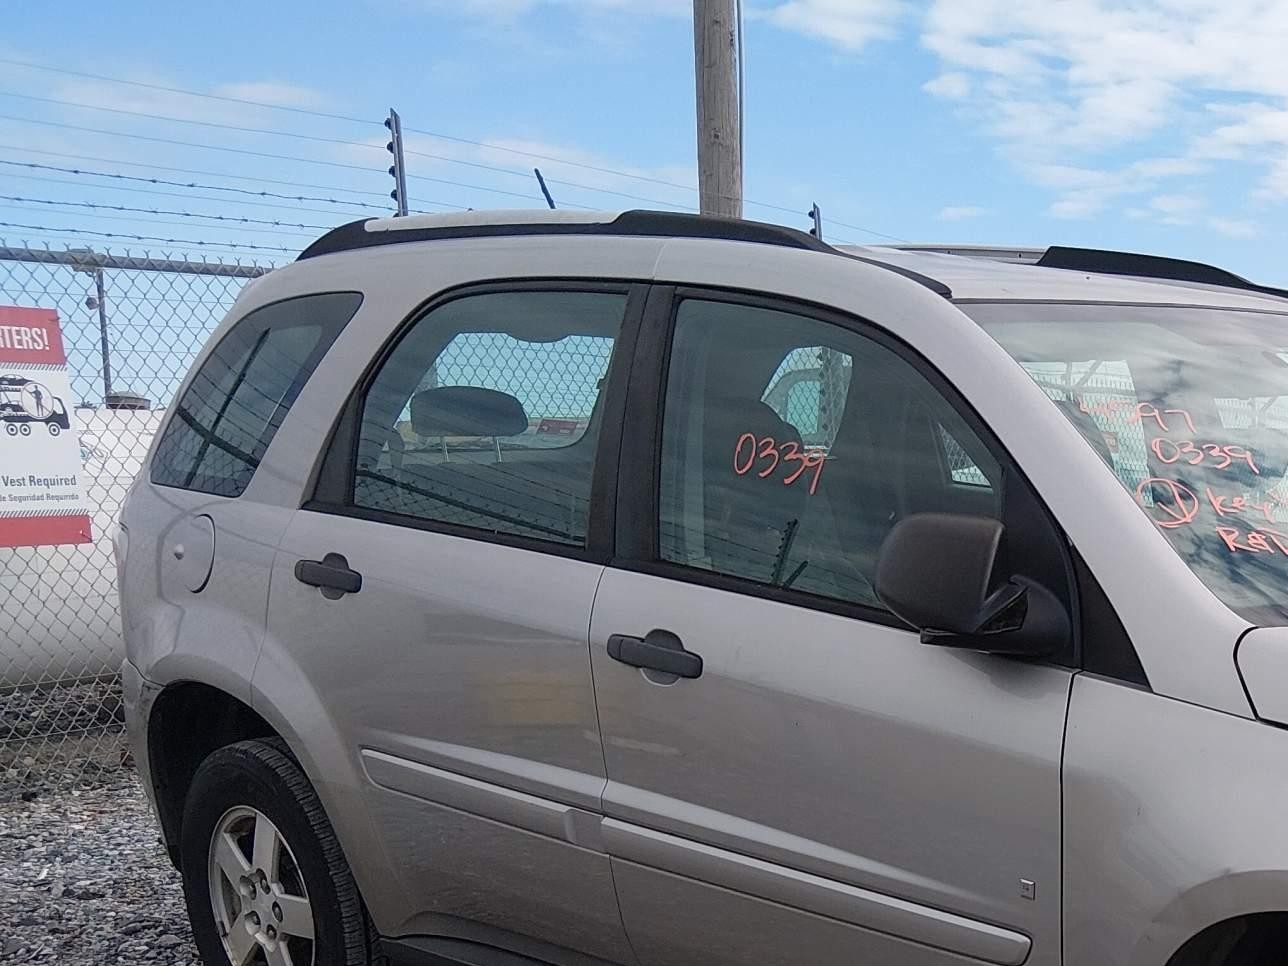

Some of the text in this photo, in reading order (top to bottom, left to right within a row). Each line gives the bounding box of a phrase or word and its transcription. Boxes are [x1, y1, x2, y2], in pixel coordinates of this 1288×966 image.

[733, 432, 826, 496] 0339
[1151, 437, 1260, 475] 0339
[1, 474, 77, 489] Vest Required
